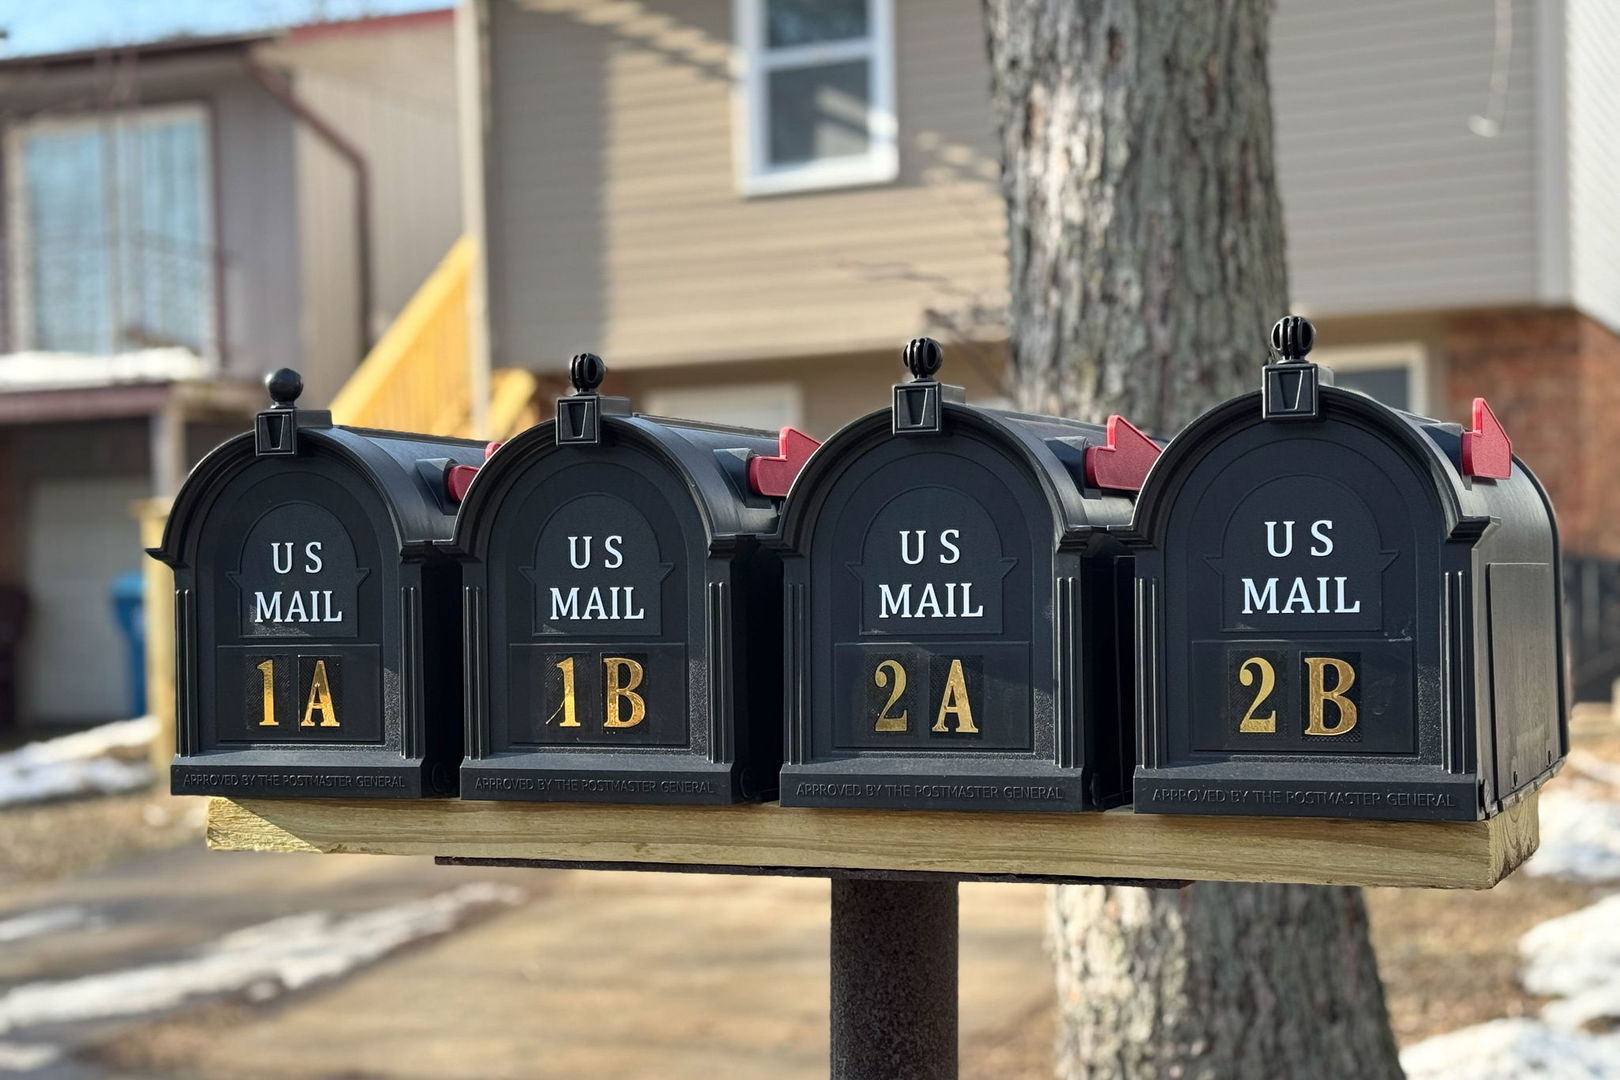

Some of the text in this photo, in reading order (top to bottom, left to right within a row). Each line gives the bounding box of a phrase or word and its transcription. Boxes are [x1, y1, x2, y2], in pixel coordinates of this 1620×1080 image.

[254, 590, 343, 623] MAIL
[549, 586, 645, 620] MAIL
[878, 582, 984, 619] MAIL
[1241, 576, 1361, 614] MAIL
[183, 774, 406, 788] APPROVED BY THE POSTMASTER GENERAL
[475, 777, 714, 794] APPROVED BY THE POSTMASTER GENERAL
[796, 783, 1064, 800] APPROVED BY THE POSTMASTER GENERAL
[1152, 789, 1456, 807] APPROVED BY THE POSTMASTER GENERAL
